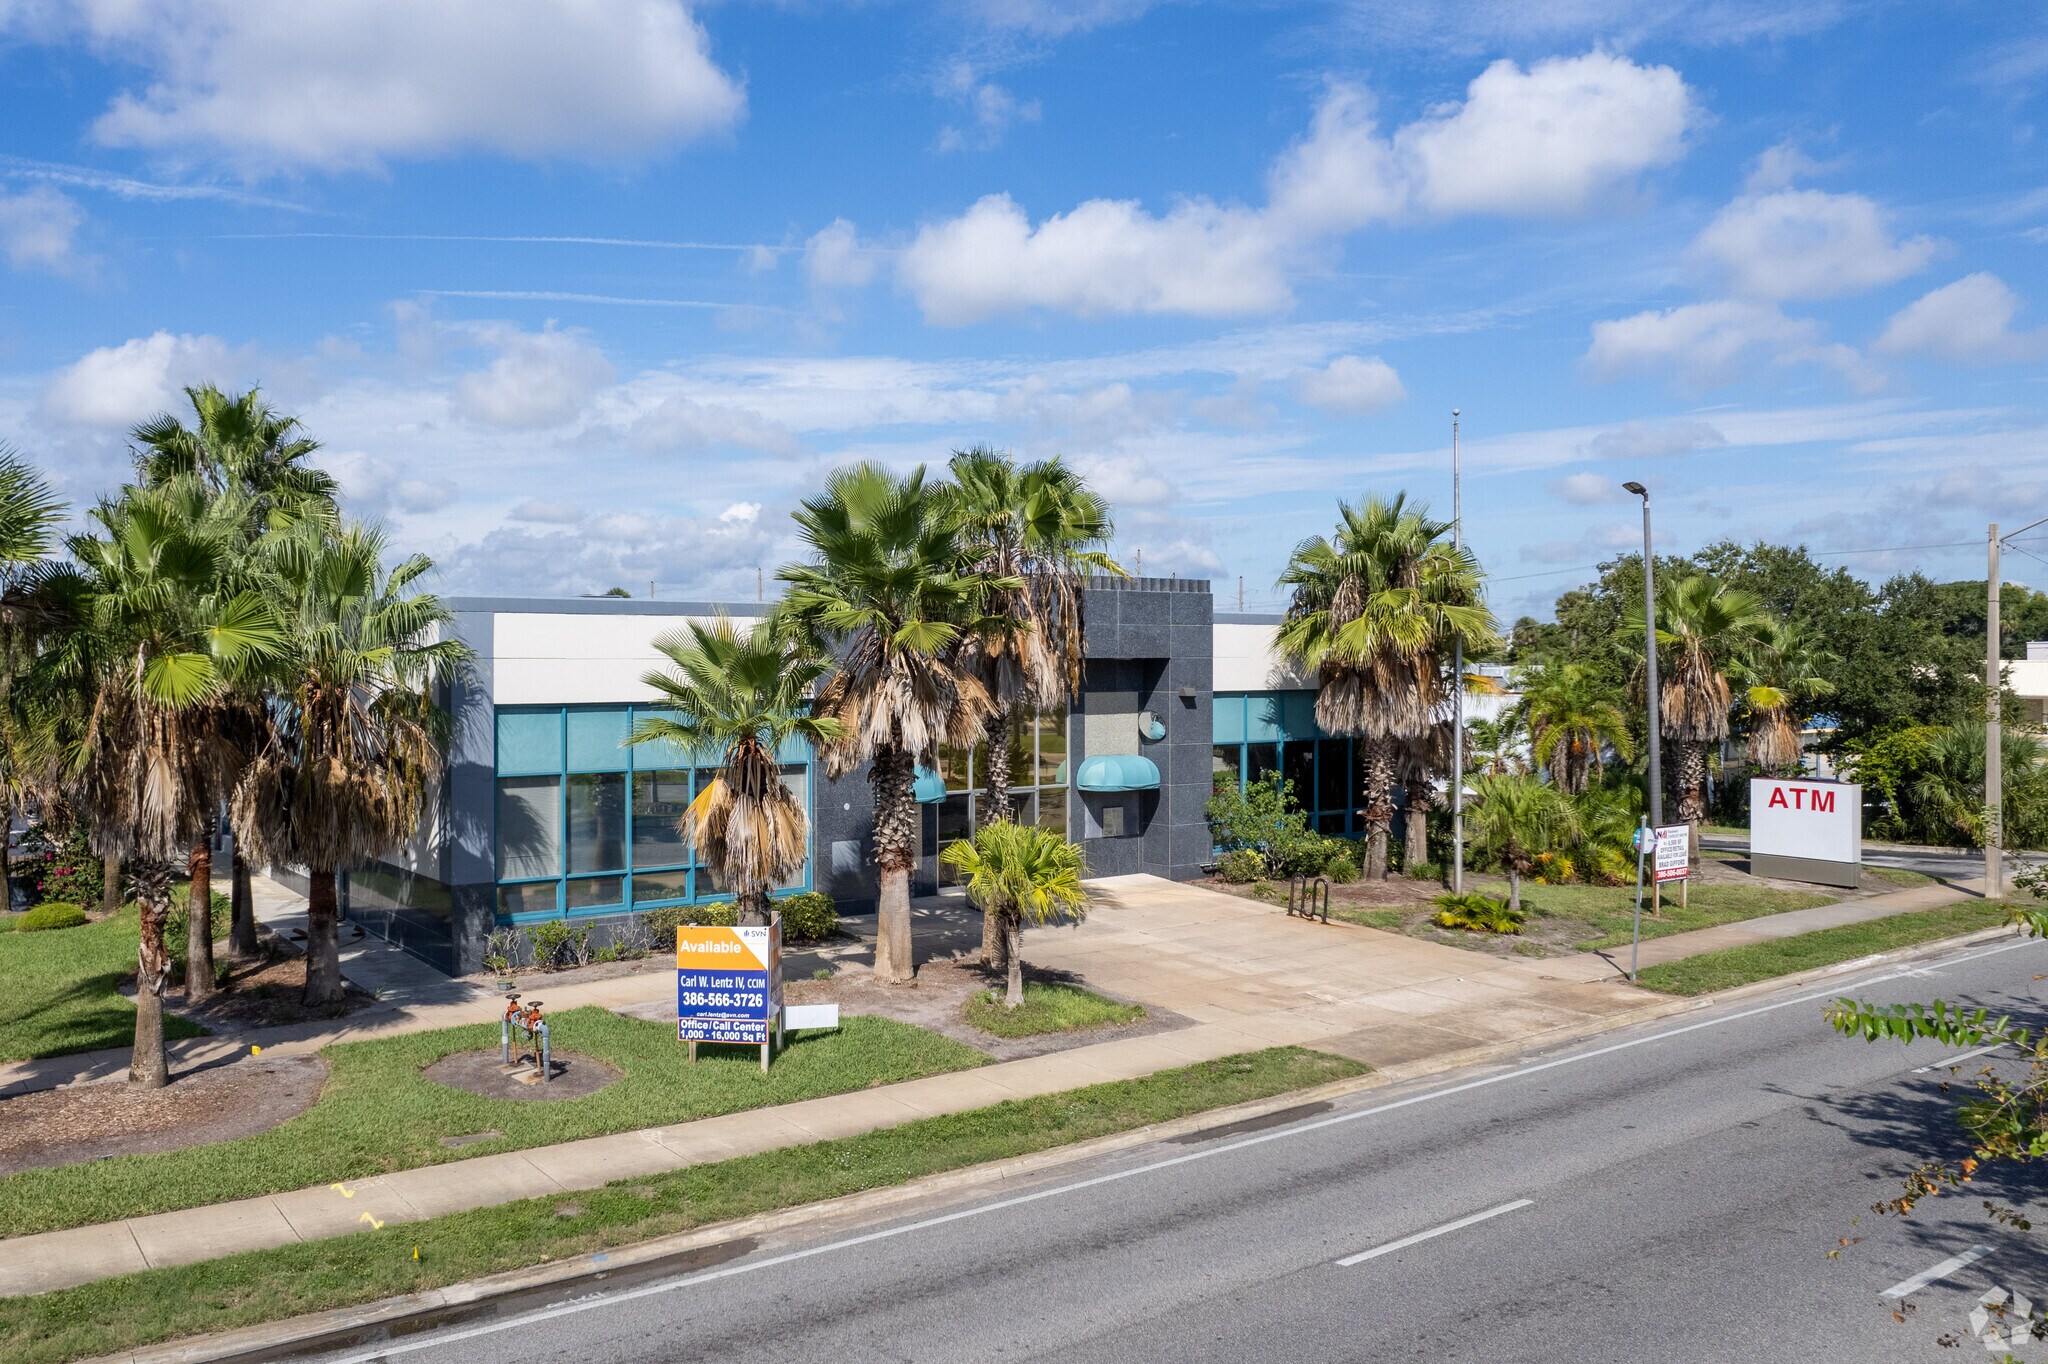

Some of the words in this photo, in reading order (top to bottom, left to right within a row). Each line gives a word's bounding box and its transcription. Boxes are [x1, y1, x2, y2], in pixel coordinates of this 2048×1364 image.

[1768, 787, 1835, 813] ATM
[680, 940, 742, 954] Available
[680, 975, 696, 987] Carl
[698, 976, 709, 988] W.
[711, 976, 733, 988] Lentz
[735, 977, 745, 990] IV,
[747, 978, 766, 988] CCIM
[683, 992, 763, 1007] 386-566-3726
[733, 1022, 766, 1032] Center
[681, 1030, 704, 1040] 1,000
[712, 1031, 740, 1041] 16,000
[742, 1032, 754, 1042] Sq
[756, 1033, 766, 1041] Ft
